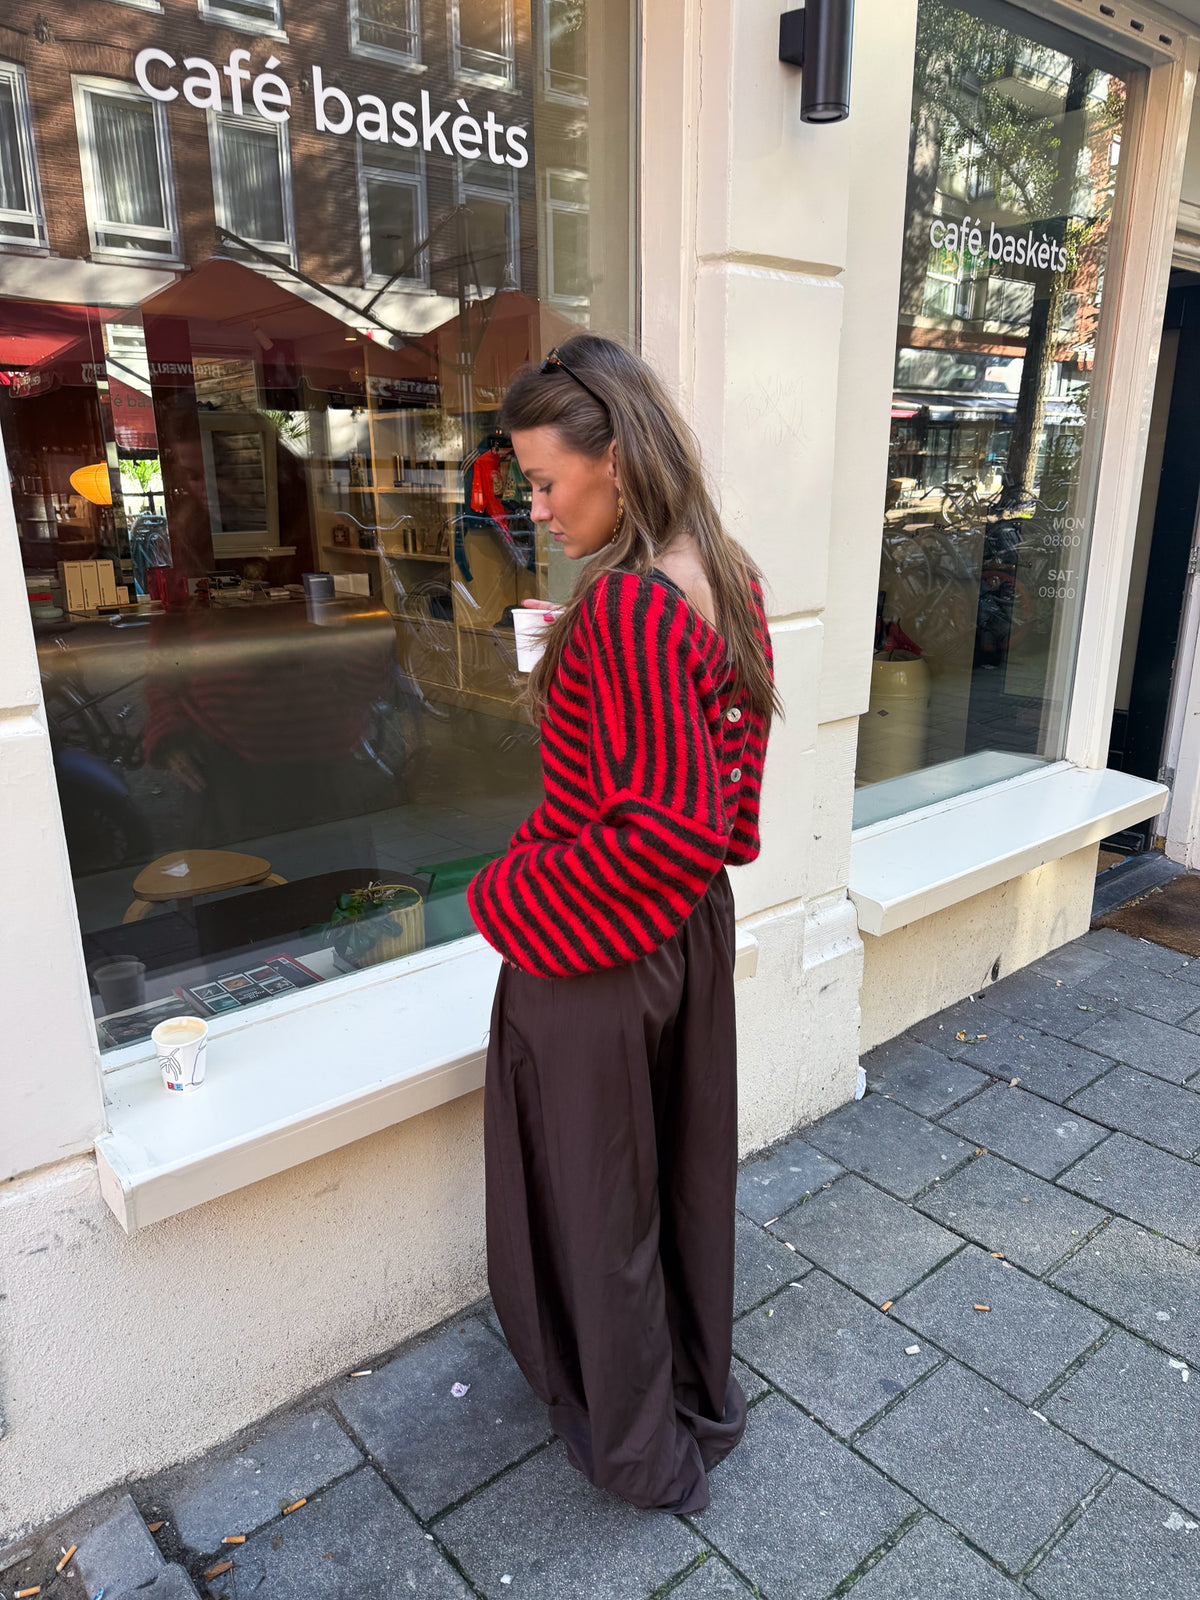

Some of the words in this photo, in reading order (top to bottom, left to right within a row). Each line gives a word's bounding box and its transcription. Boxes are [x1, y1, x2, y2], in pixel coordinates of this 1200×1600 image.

[133, 48, 292, 123] café
[311, 65, 529, 168] baskèts
[930, 216, 982, 256] café
[988, 221, 1068, 273] baskèts
[1053, 517, 1085, 529] MON
[1043, 535, 1080, 547] 08:00
[1048, 569, 1074, 581] SAT
[1039, 586, 1075, 599] 09:00
